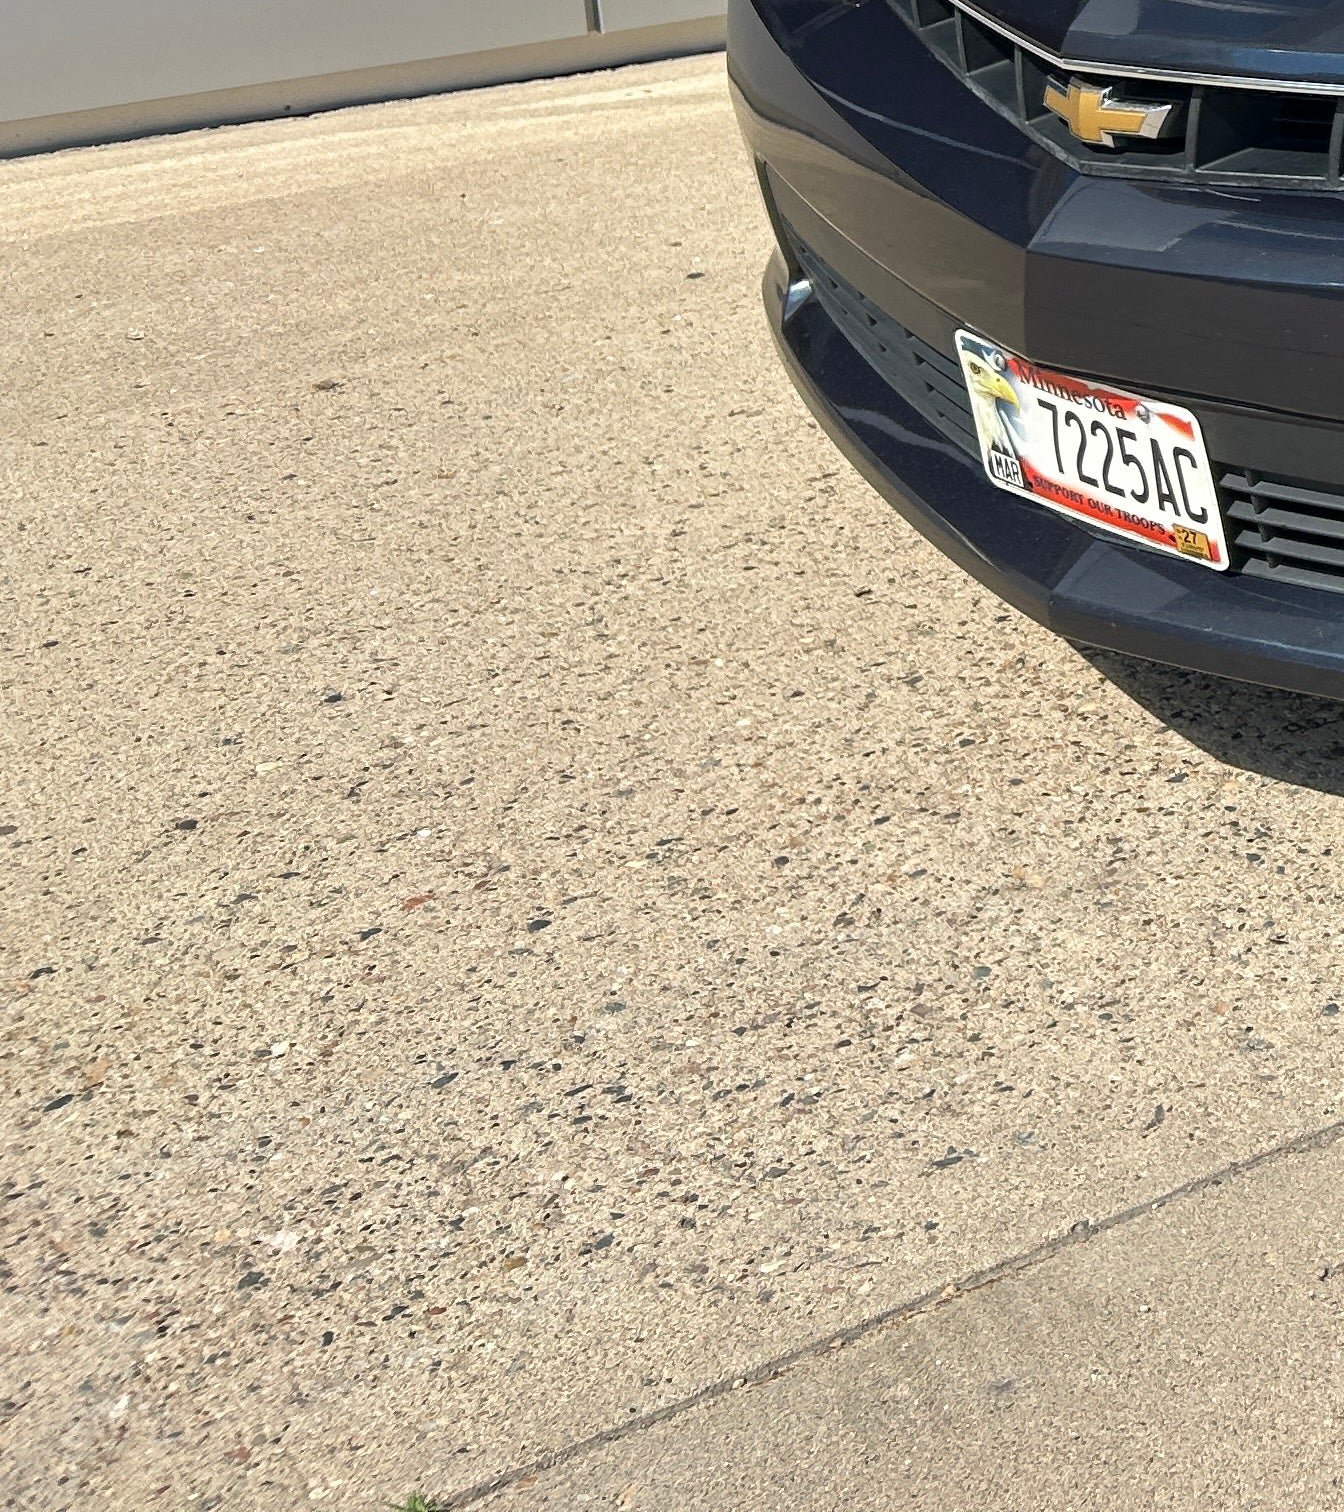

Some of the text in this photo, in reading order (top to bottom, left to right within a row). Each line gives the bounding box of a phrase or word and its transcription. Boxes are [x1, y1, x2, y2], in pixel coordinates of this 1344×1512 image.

[1018, 363, 1127, 420] Minnesota
[994, 454, 1021, 483] MAR
[1037, 398, 1208, 525] 7225AC
[1033, 475, 1085, 505] SUPPORT
[1087, 498, 1114, 516] OUR
[1114, 508, 1165, 535] TROOPS
[1182, 529, 1197, 545] 27
